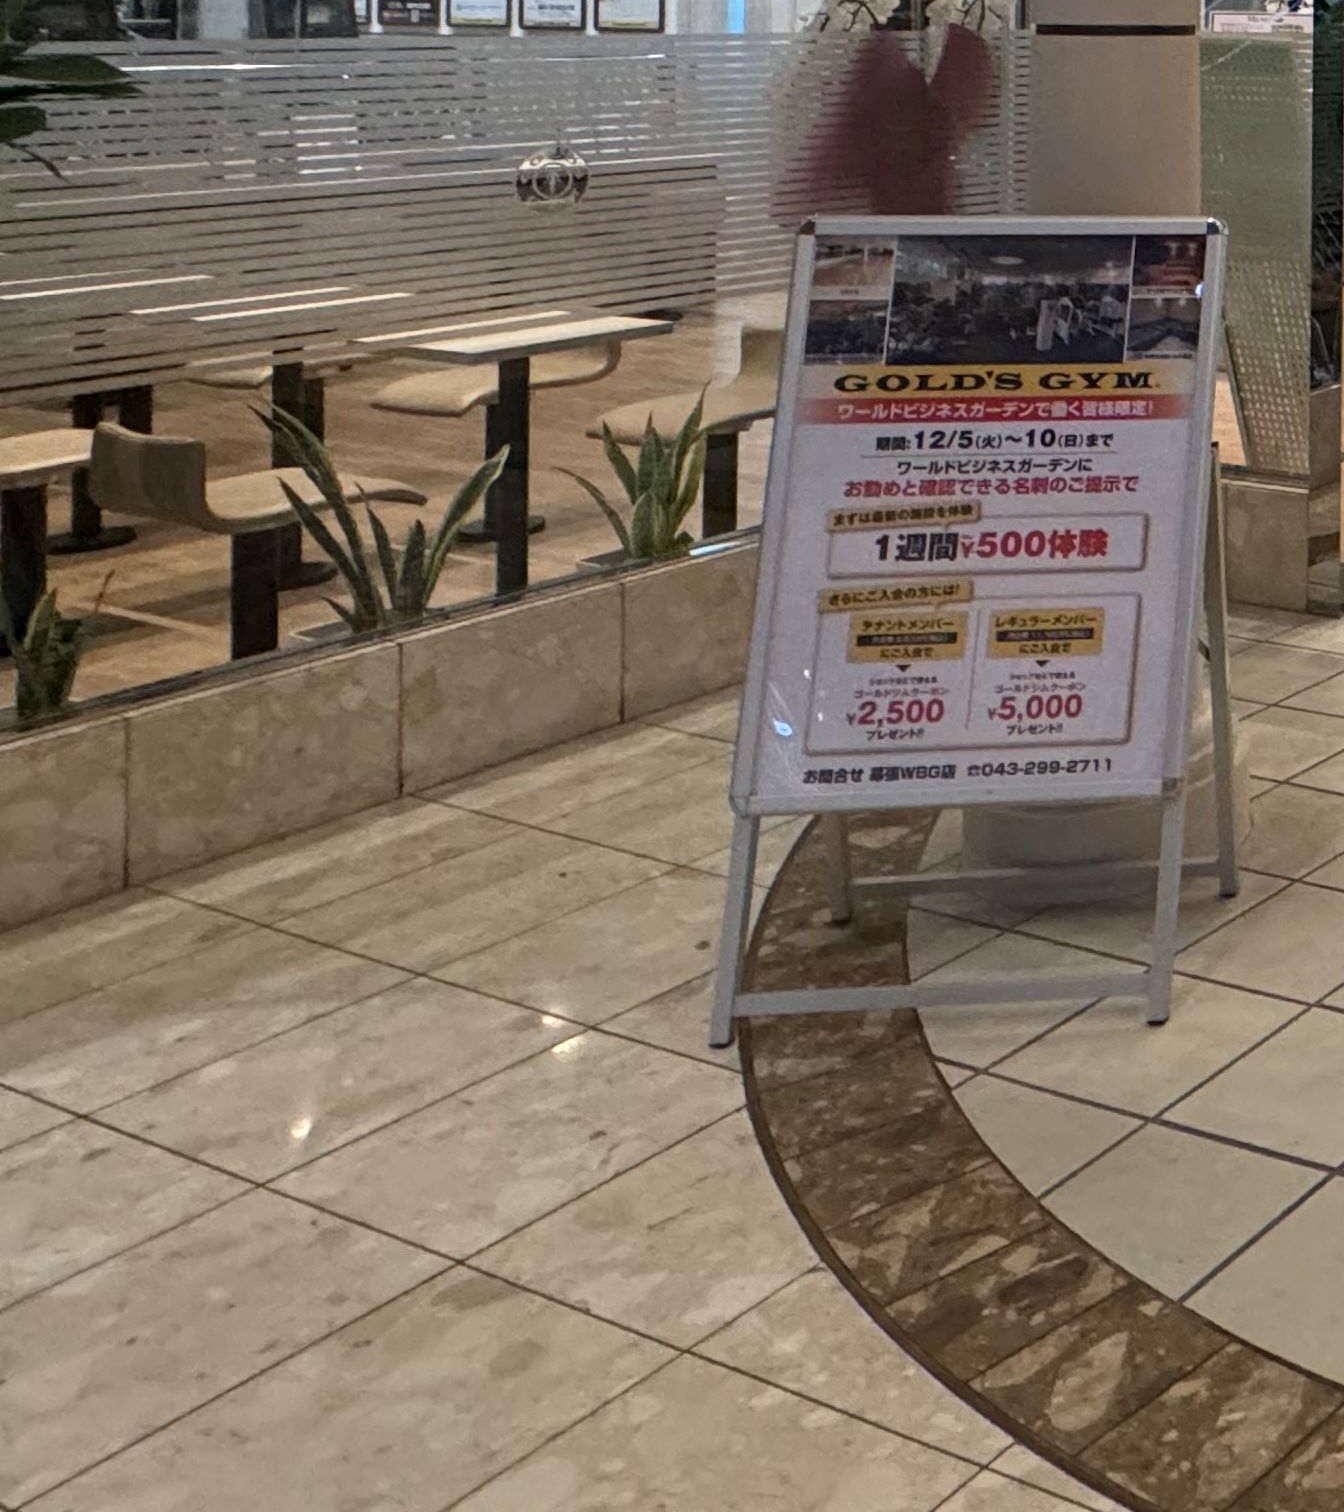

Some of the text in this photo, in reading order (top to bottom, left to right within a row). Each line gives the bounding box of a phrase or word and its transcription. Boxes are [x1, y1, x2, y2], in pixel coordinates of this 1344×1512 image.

[833, 370, 1155, 393] GOLD'S GYM
[896, 457, 1093, 476] ワールドビジネスガーデンに
[843, 474, 1140, 499] お勤めと確認できる名刺のご提示で
[994, 614, 1098, 629] レギュラーメンバー
[802, 766, 865, 786] お問合せ
[869, 763, 957, 783] 幕張WBG店
